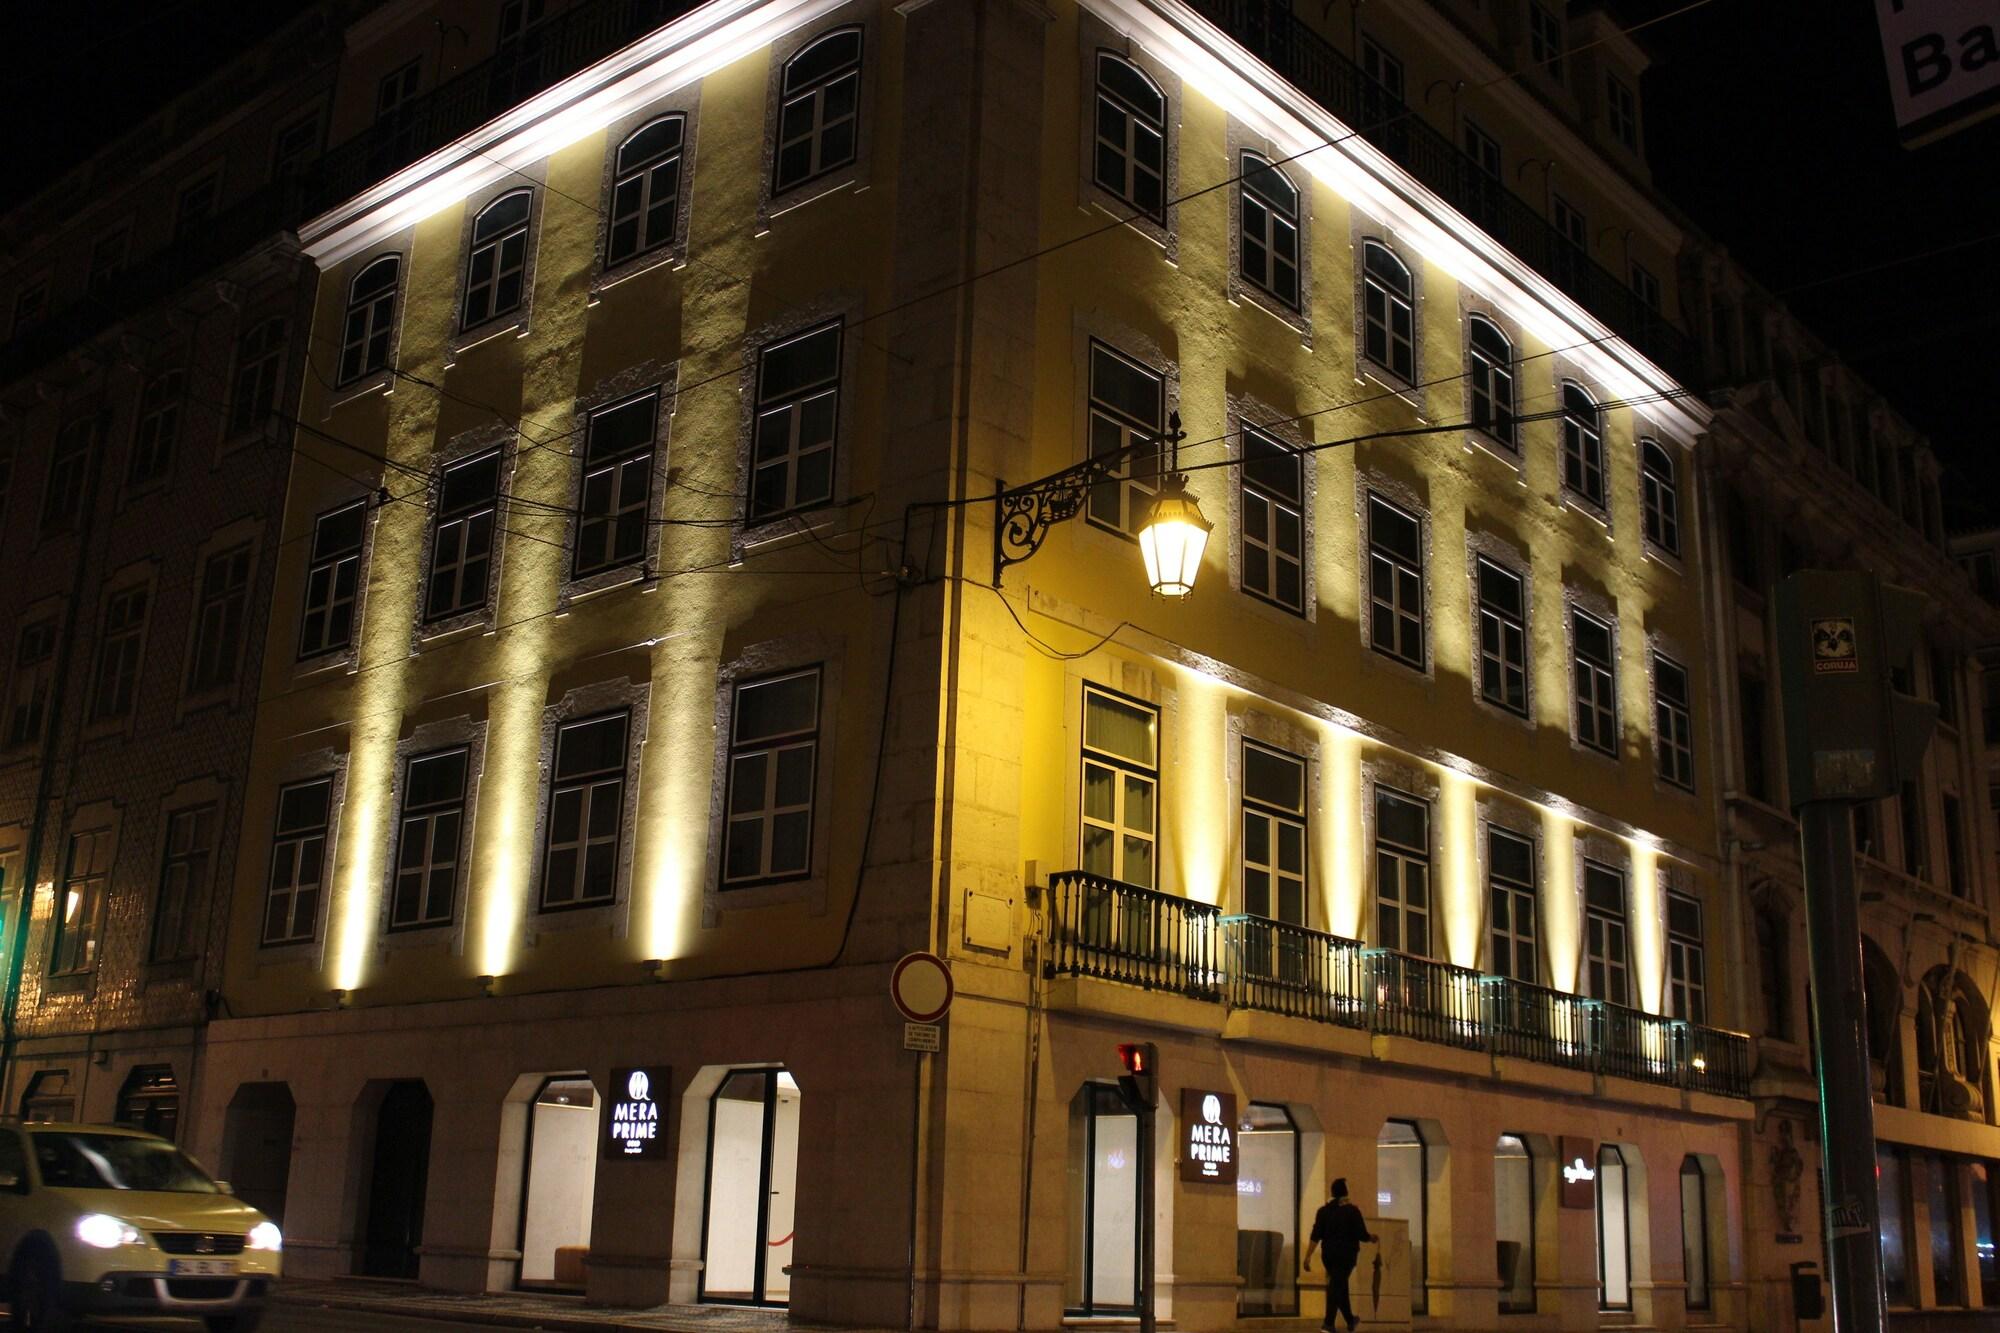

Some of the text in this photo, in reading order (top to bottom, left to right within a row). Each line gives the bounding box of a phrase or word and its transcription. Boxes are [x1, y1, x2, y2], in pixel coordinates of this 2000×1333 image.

[614, 1102, 657, 1121] MERA
[612, 1122, 657, 1139] PRIME
[1191, 1124, 1231, 1145] MERA
[1190, 1143, 1230, 1163] PRIME
